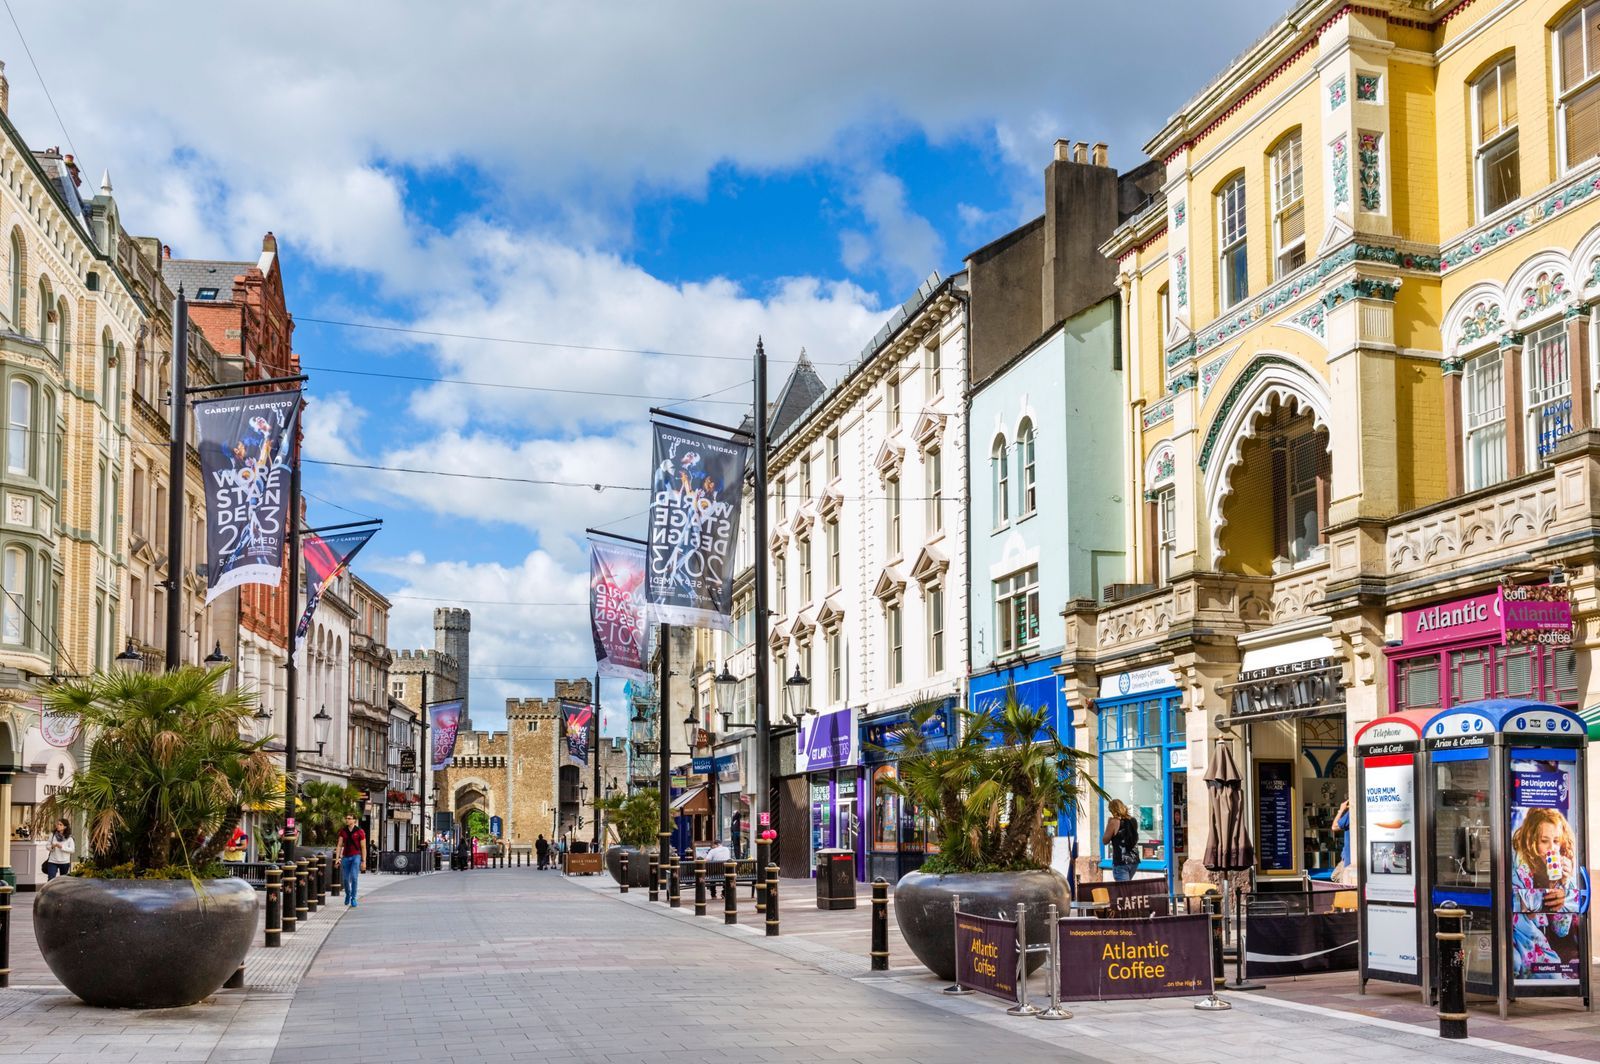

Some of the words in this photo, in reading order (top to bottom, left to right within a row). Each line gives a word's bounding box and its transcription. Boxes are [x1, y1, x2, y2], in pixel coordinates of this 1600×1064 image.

[204, 406, 240, 415] CARDIFF
[248, 401, 293, 411] CAERDYDD
[1544, 400, 1572, 416] ADVIC
[1555, 416, 1562, 425] &
[1504, 587, 1527, 600] coffi
[1415, 600, 1488, 632] Atlantic
[1506, 606, 1569, 622] Atlantic
[1538, 633, 1571, 643] coffee
[1238, 669, 1267, 682] HIGH
[1275, 657, 1326, 675] STREET
[1373, 728, 1402, 738] Telephone
[812, 748, 818, 760] GT
[818, 746, 828, 759] LAW
[1369, 746, 1383, 755] Coins
[1383, 745, 1388, 753] &
[1389, 744, 1404, 752] Cards
[1521, 779, 1529, 787] Be
[1530, 779, 1559, 788] Uniproof
[1367, 787, 1381, 795] YOUR
[1367, 795, 1379, 803] WAS
[1380, 794, 1402, 802] WRONG.
[1116, 895, 1151, 911] CAFFE
[1070, 929, 1102, 937] Independent
[971, 937, 999, 959] Atlantic
[1102, 941, 1170, 961] Atlantic
[974, 957, 996, 977] Coffee
[1108, 961, 1165, 980] Coffee
